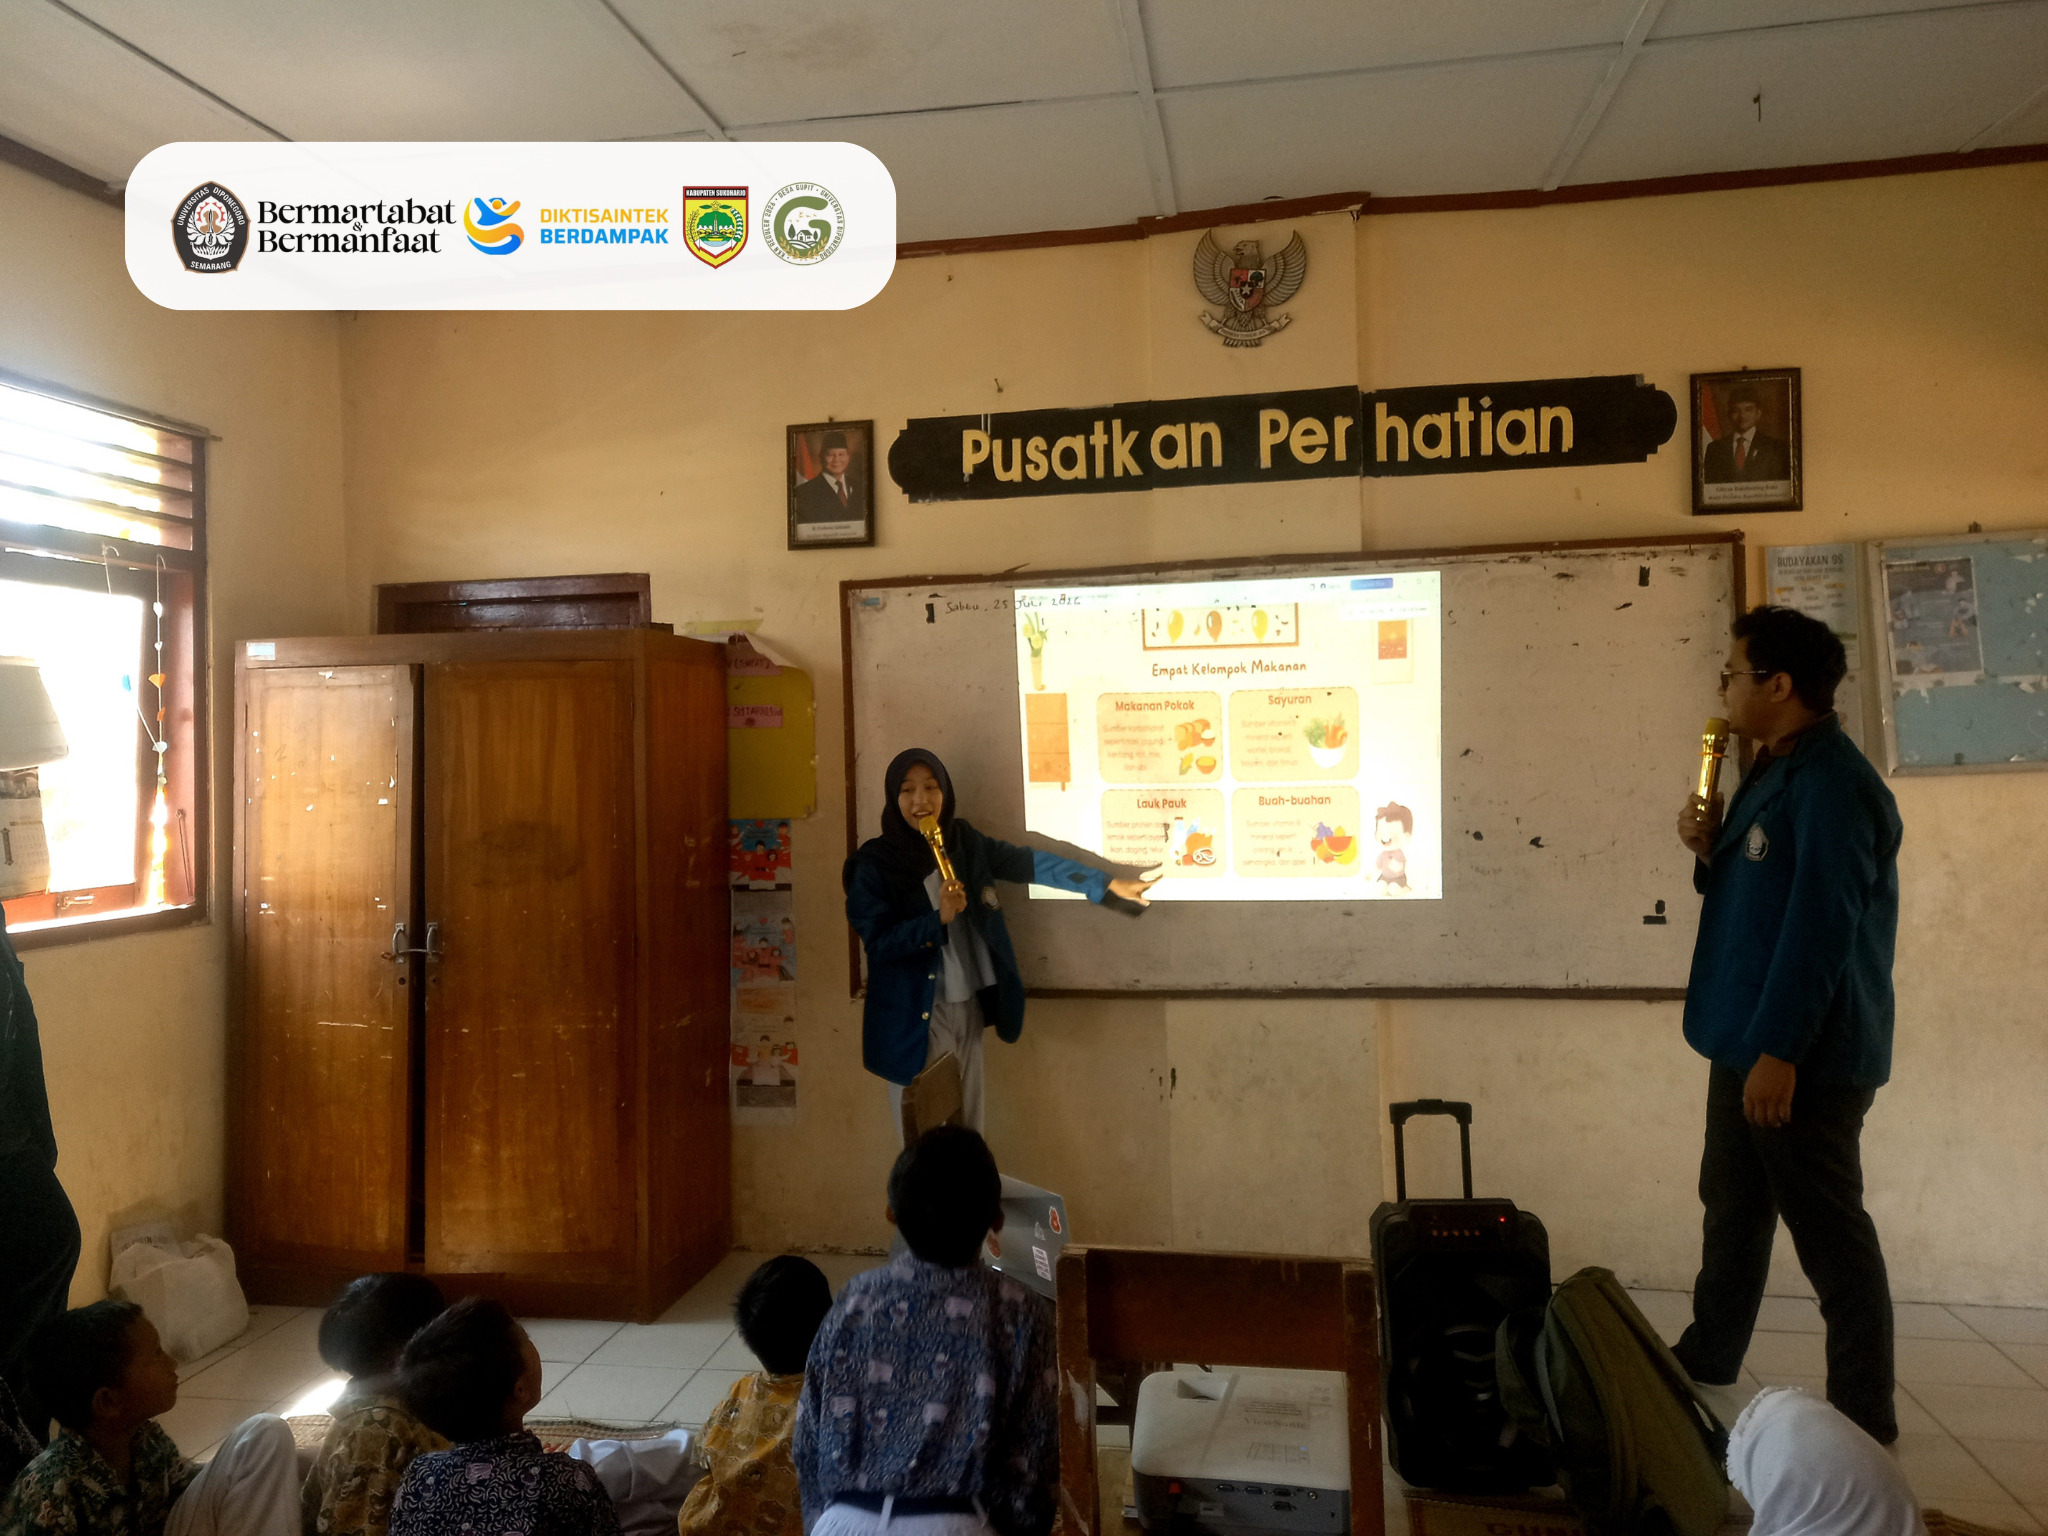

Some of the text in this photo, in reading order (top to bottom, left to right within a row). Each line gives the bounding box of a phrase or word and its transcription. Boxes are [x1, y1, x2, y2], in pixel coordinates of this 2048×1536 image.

[962, 419, 1222, 483] Pusatkan
[1777, 555, 1829, 568] BUDAYAKAN
[1152, 659, 1307, 680] Empat Kelompok Makanan
[1115, 699, 1195, 711] Makanan Pokok
[1268, 694, 1312, 708] Sayuran
[1136, 798, 1187, 809] Lauk Pauk
[1258, 795, 1331, 806] Buah-buahan
